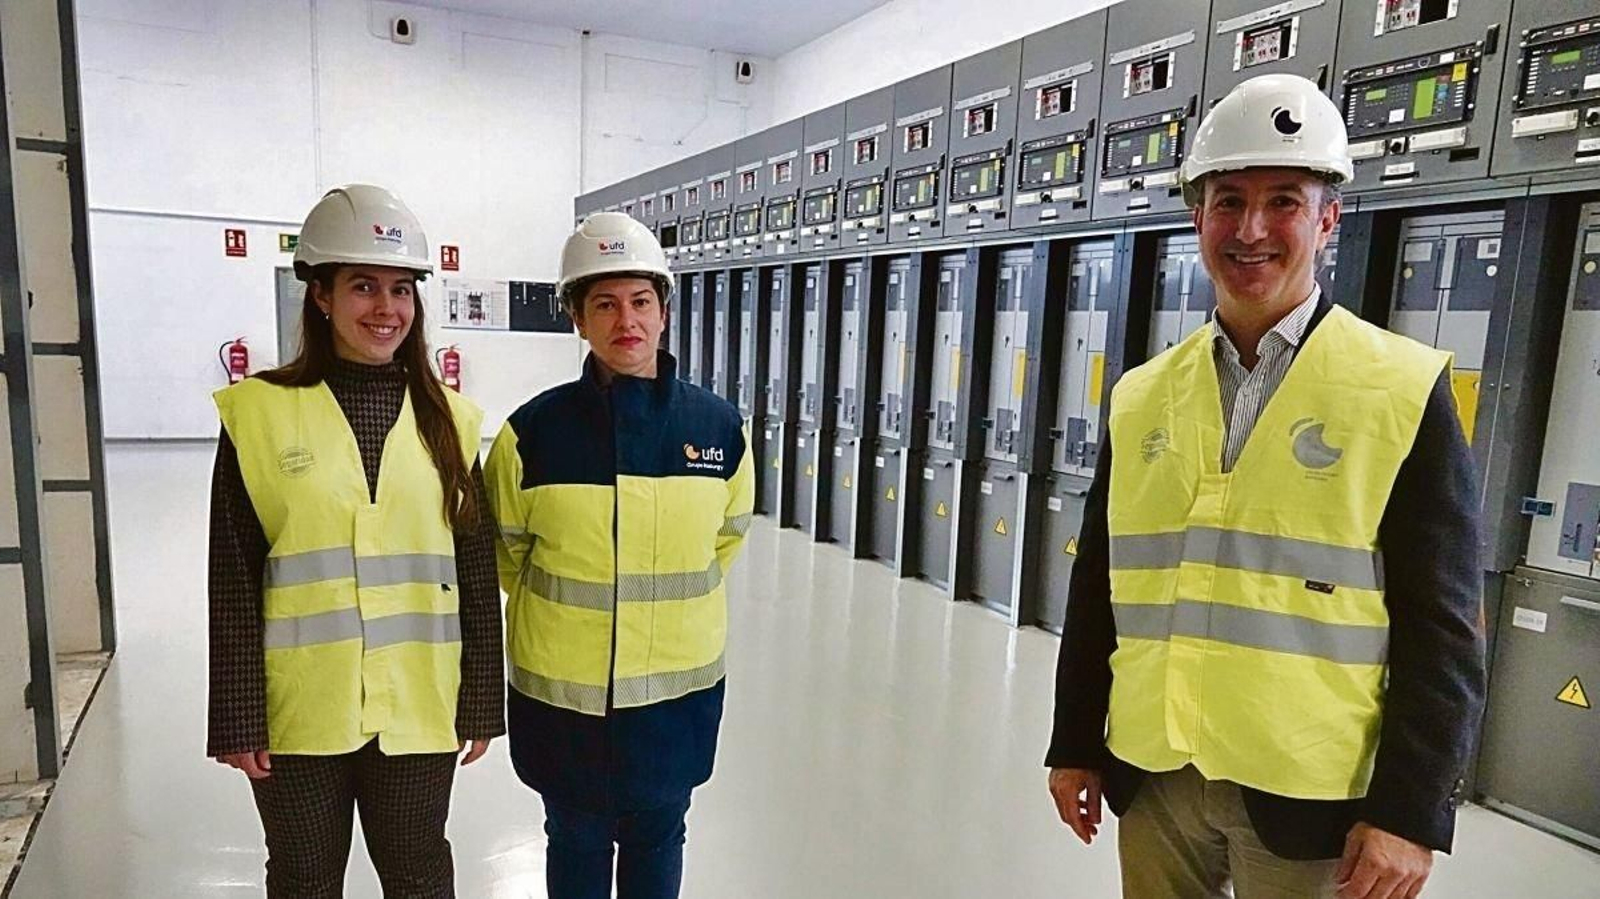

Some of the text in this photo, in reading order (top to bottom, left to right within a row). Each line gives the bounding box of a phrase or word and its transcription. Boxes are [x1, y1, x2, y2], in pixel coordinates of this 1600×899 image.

[386, 227, 401, 238] ufd
[609, 241, 625, 250] ufd
[702, 447, 724, 461] ufd
